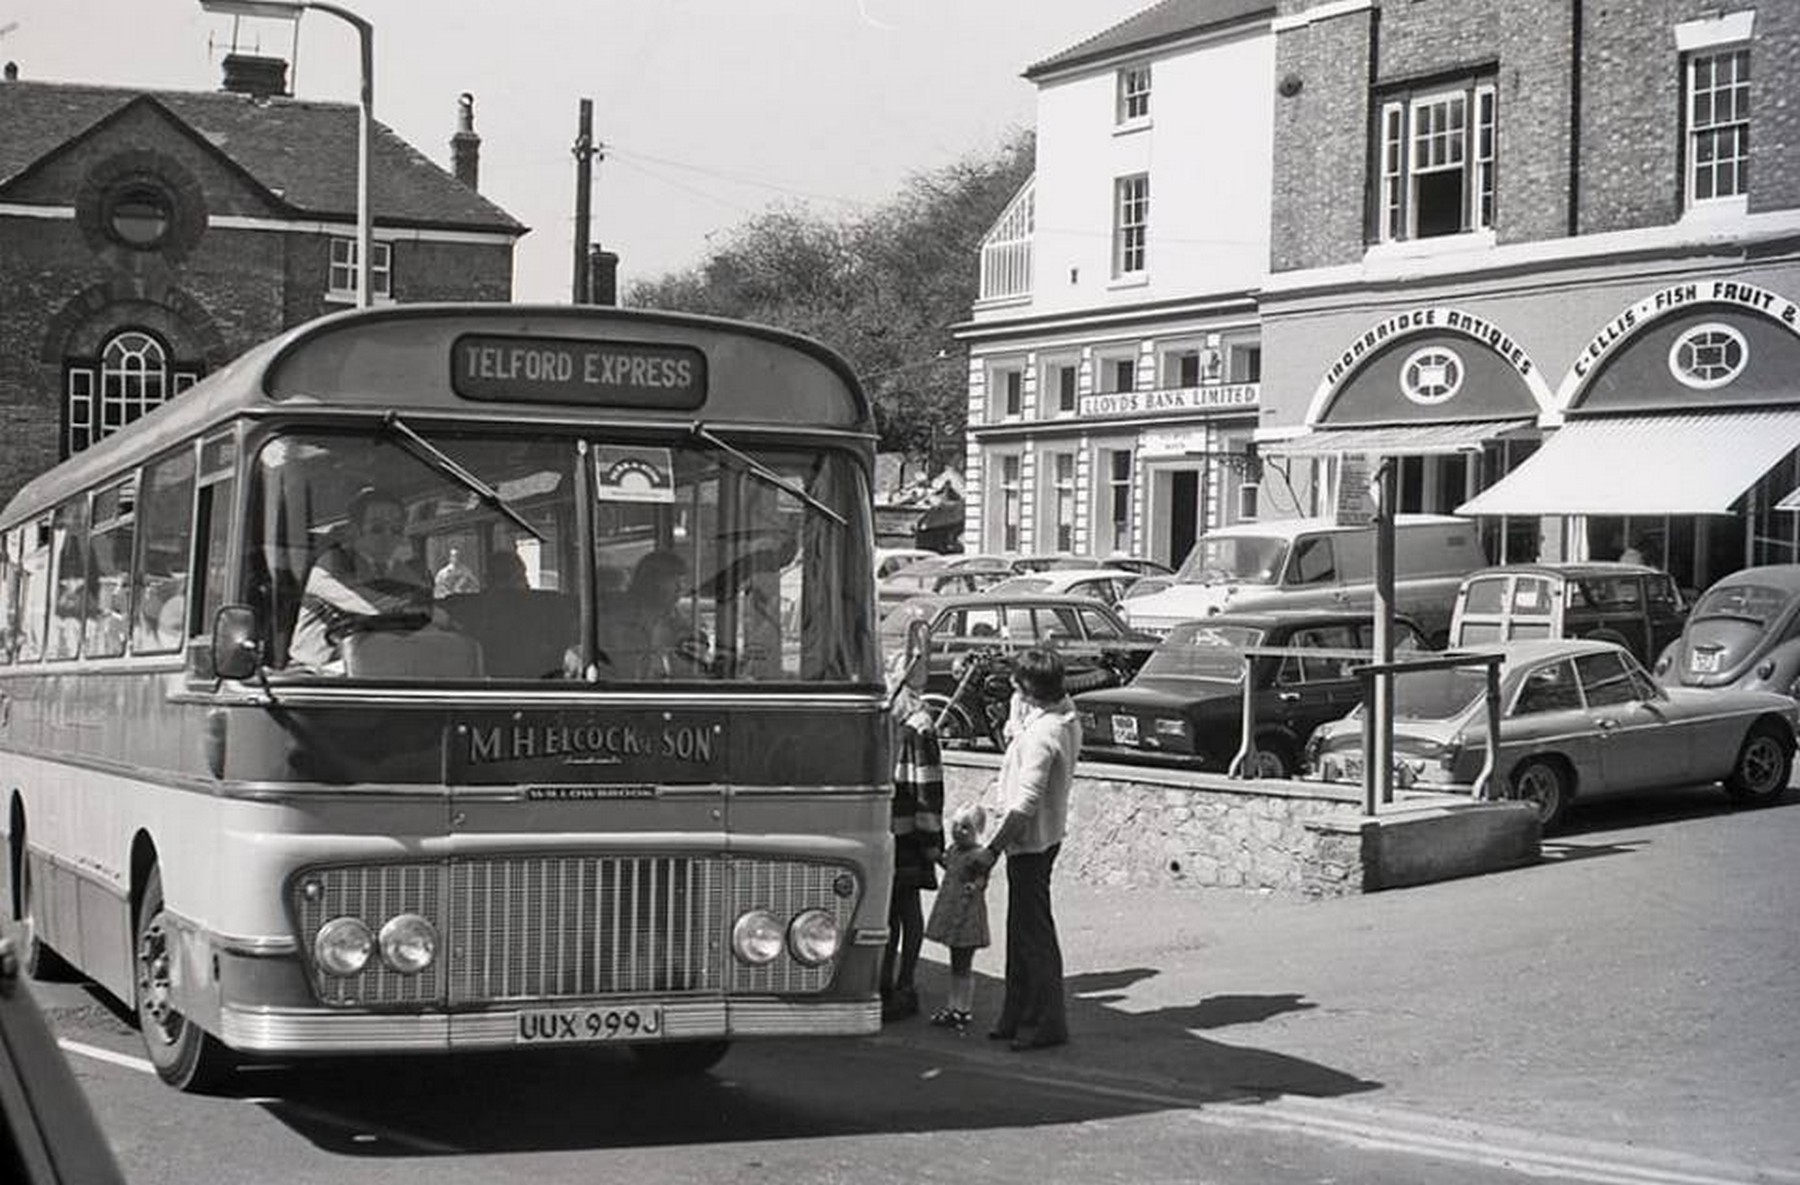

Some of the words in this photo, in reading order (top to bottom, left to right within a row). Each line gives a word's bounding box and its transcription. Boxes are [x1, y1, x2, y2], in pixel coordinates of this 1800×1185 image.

[1655, 285, 1697, 309] FISH
[1713, 283, 1774, 309] FRUIT
[1782, 304, 1796, 325] &
[1327, 310, 1435, 384] IRONBRIDGE
[1447, 311, 1531, 376] ANTIQUES
[466, 346, 572, 381] TELFORD
[584, 353, 691, 388] EXPRESS
[1085, 397, 1139, 414] LLOYDS
[1145, 393, 1185, 410] BANK
[1194, 386, 1256, 406] LIMITED
[546, 725, 639, 753] ELCOCK
[661, 727, 711, 761] SON
[519, 1013, 576, 1040] UUX
[585, 1010, 660, 1037] 999J
